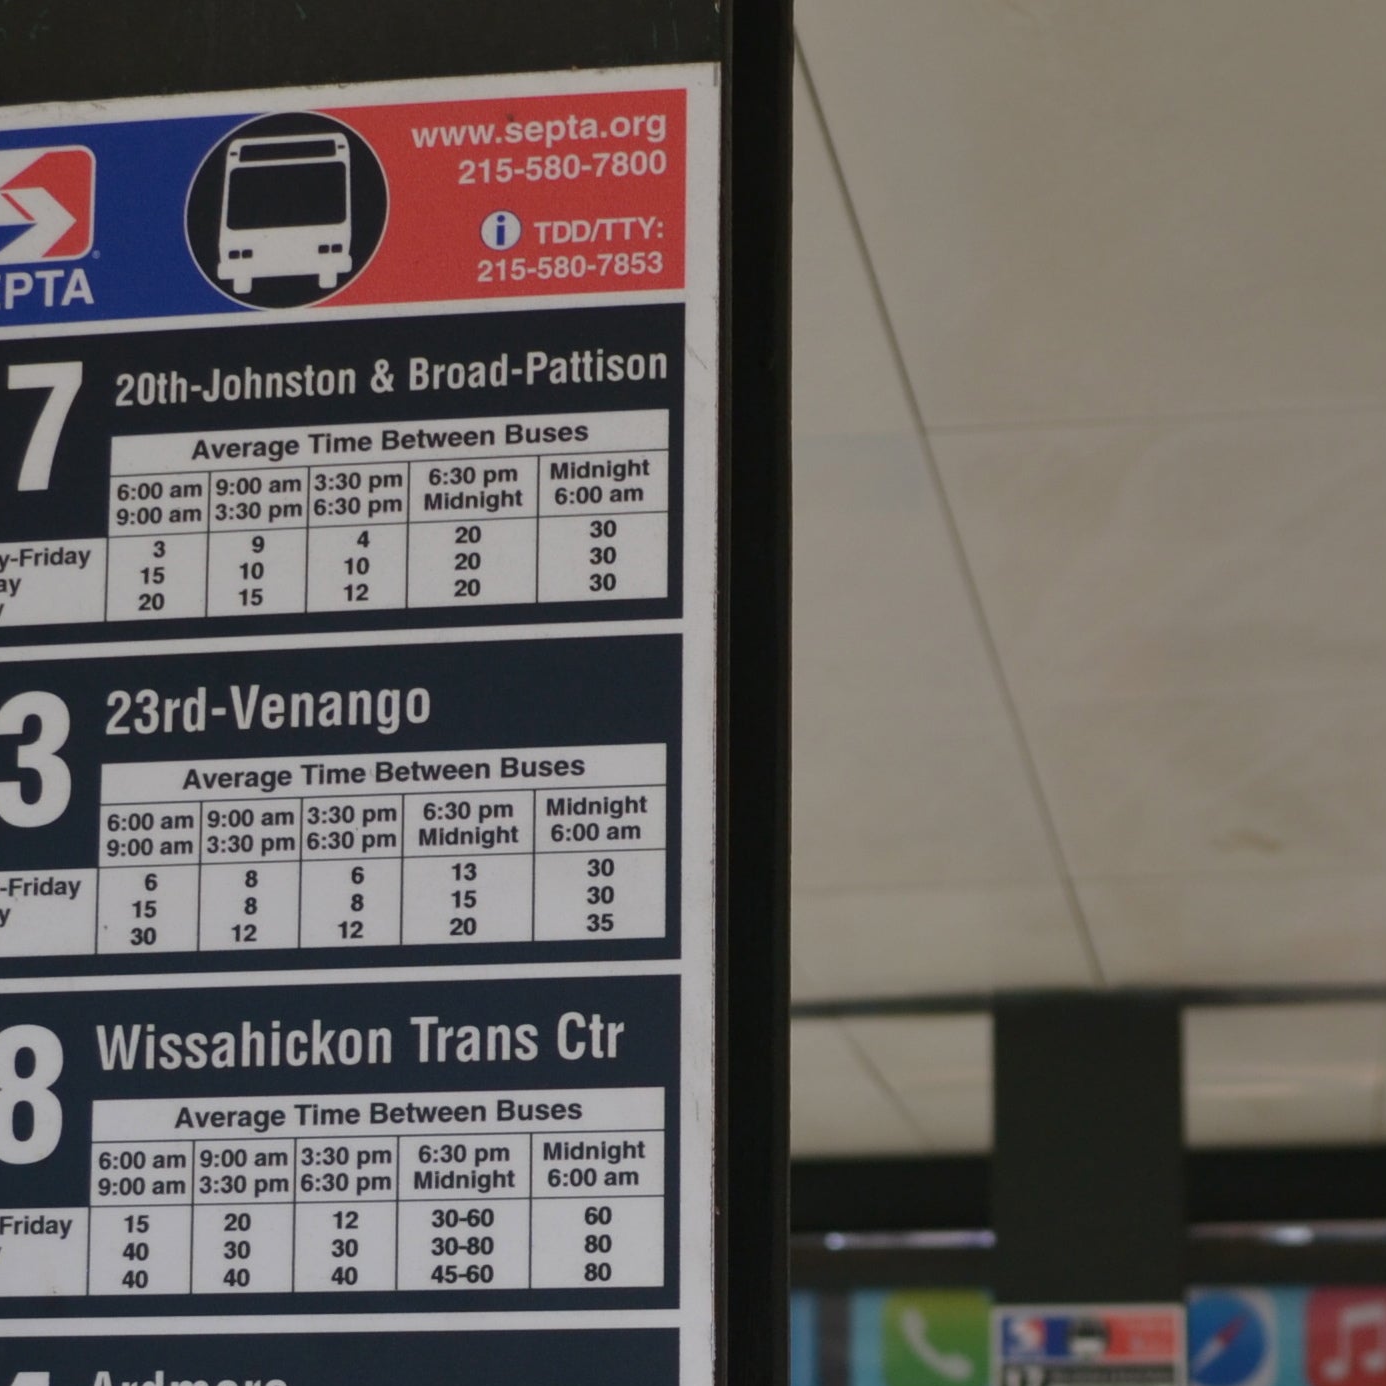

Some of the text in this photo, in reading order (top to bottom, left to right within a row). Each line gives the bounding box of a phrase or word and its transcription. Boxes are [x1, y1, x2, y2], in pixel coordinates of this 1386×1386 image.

[411, 115, 665, 148] www.septa.org
[458, 150, 666, 185] 215-580-7800
[534, 216, 663, 244] TDD/TTY:
[477, 251, 662, 282] 215-580-7853
[115, 348, 666, 407] 20th-Johnston & Broad-Pattison
[190, 423, 590, 463] Average Time Between Buses
[117, 458, 651, 502] 6:00 am 9:00 am 3:30 pm 6:30 pm Midnight
[116, 485, 645, 527] 9:00 am 3:30 pm 6:30 pm Midnight 6:00 am
[152, 539, 167, 559] 3
[250, 534, 266, 555] 9
[355, 529, 371, 549] 4
[454, 524, 483, 545] 20
[589, 519, 618, 539] 30
[139, 565, 166, 585] 15
[238, 561, 265, 581] 10
[343, 556, 371, 576] 10
[453, 551, 482, 571] 20
[589, 545, 618, 566] 30
[137, 592, 166, 611] 20
[237, 587, 264, 606] 15
[342, 582, 370, 602] 12
[453, 578, 482, 597] 20
[589, 572, 617, 592] 30
[105, 684, 430, 735] 23rd-Venango
[181, 757, 586, 794] Average Time Between Buses
[95, 1011, 625, 1071] Wissahickon Trans Ctr
[173, 1099, 584, 1134] Average Time Between Buses
[430, 1207, 495, 1229] 30-60
[583, 1205, 613, 1226] 60
[430, 1235, 495, 1257] 30-80
[583, 1233, 613, 1254] 80
[430, 1263, 495, 1284] 45-60
[583, 1262, 613, 1282] 80
